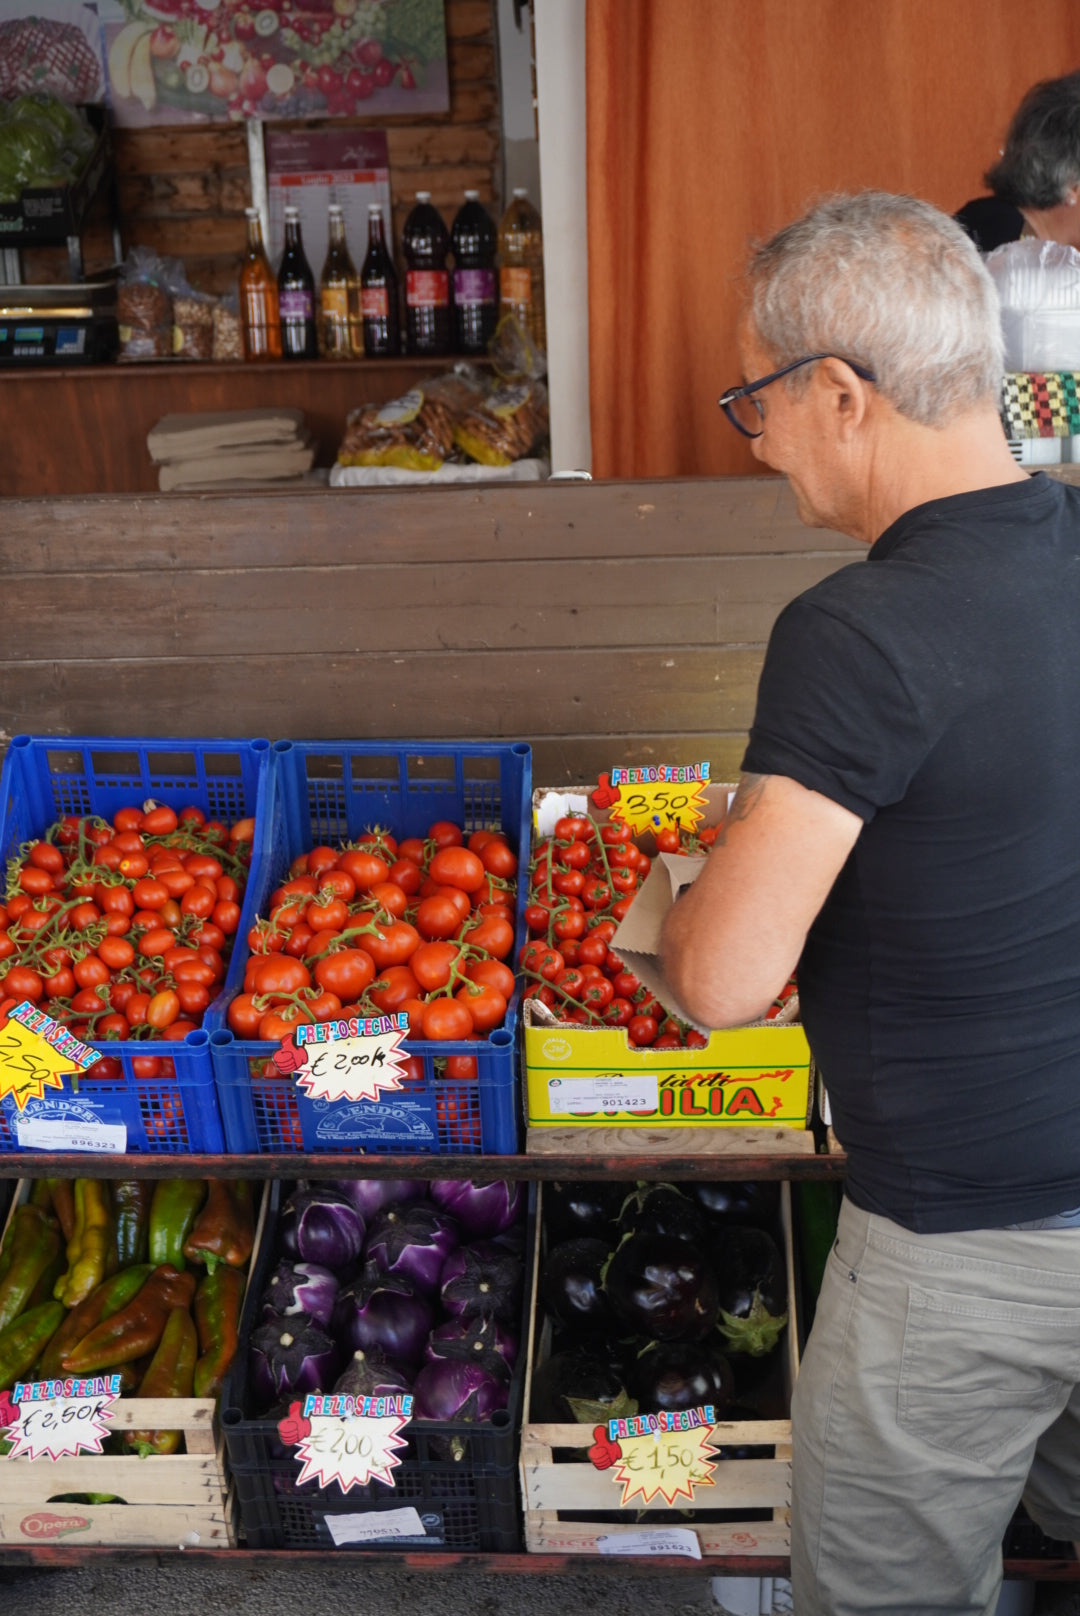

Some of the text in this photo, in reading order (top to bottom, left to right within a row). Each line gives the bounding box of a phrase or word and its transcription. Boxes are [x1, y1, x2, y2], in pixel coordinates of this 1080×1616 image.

[611, 761, 711, 787] PREZZO SPECIALE
[8, 1000, 103, 1068] PREZZO SPECIALE
[296, 1012, 409, 1046] PREZZO SPECIALE
[602, 1098, 647, 1107] 901423
[71, 1139, 116, 1150] 896323
[12, 1374, 121, 1404] PREZZO SPECIALE
[303, 1394, 413, 1417] PREZZO SPECIALE
[609, 1405, 715, 1441] PREZZO SPECIALE
[25, 1518, 80, 1533] Opera
